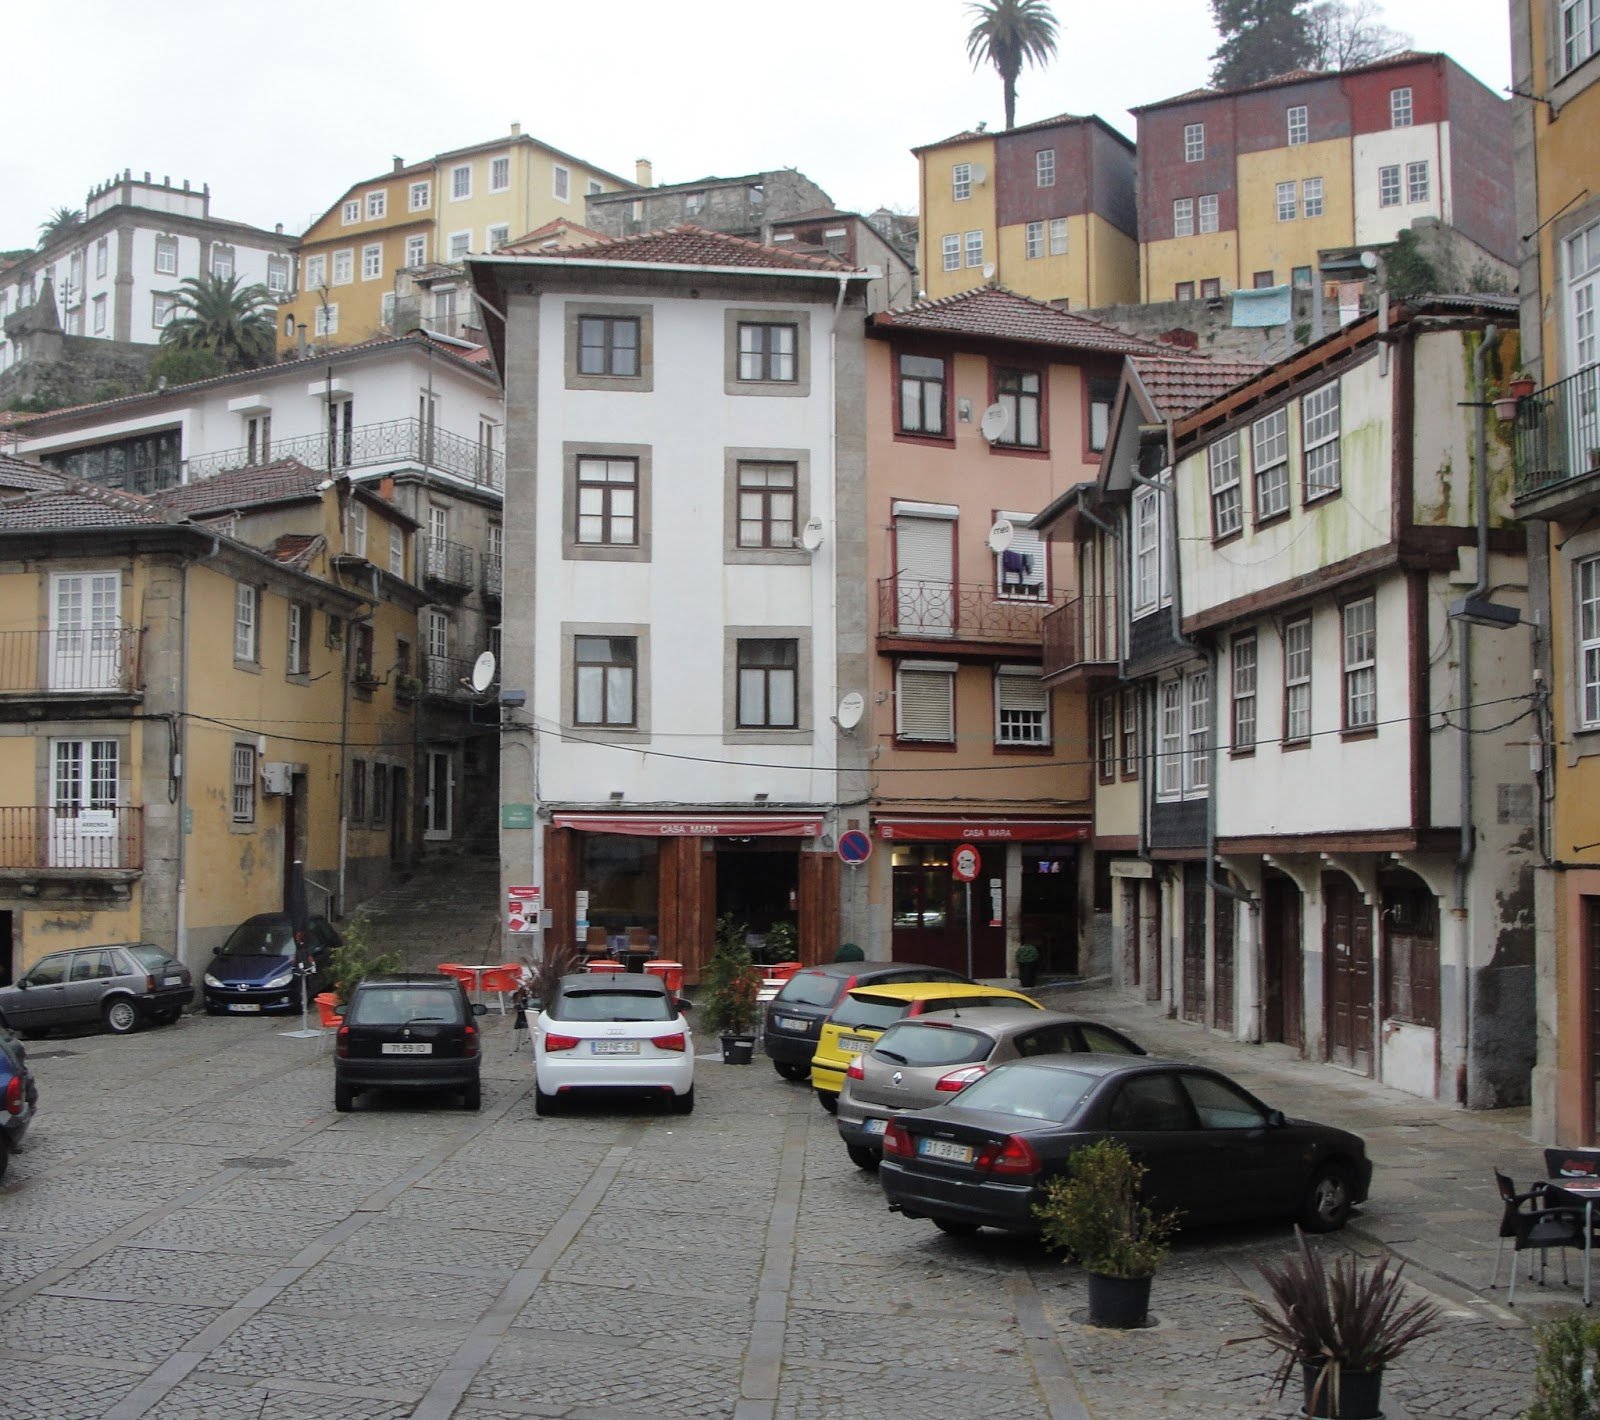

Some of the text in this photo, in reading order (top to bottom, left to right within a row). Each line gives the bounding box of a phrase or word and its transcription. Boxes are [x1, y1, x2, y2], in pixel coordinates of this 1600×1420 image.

[660, 825, 719, 834] CASA MARA
[963, 829, 1012, 837] CASA MARA
